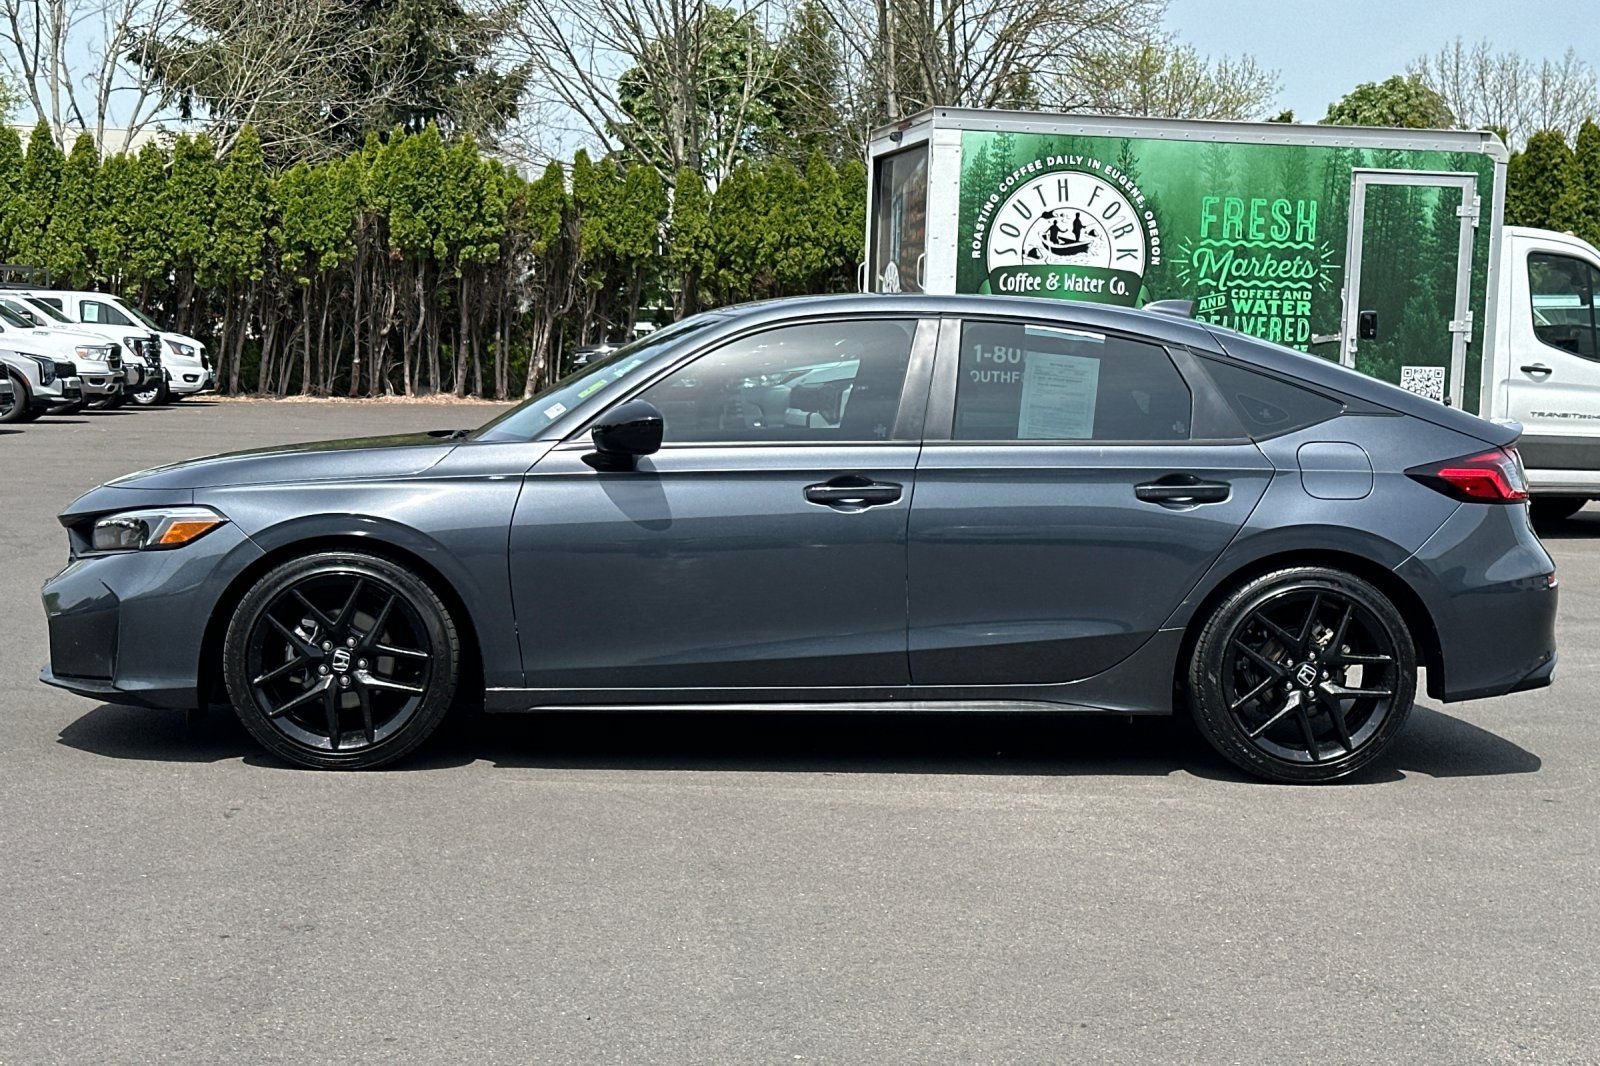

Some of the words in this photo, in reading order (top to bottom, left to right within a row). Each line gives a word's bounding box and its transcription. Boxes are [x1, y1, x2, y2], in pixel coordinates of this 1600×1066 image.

[971, 192, 1000, 259] ROASTING
[998, 159, 1043, 193] COFFEE
[1046, 155, 1084, 167] DAILY
[1087, 157, 1102, 170] IN
[1104, 165, 1147, 209] EUGENE,
[1144, 210, 1161, 266] OREGON
[994, 178, 1070, 256] SOUTH
[1086, 184, 1139, 261] FORK
[1200, 196, 1318, 242] FRESH
[998, 272, 1042, 293] Coffee
[1045, 272, 1060, 290] &
[1064, 273, 1106, 293] Water
[1109, 276, 1130, 296] Co.
[1192, 247, 1319, 291] Markets
[1199, 294, 1226, 311] AND
[1230, 288, 1281, 300] COFFEE
[1282, 290, 1312, 301] AND
[1231, 299, 1312, 316] WATER
